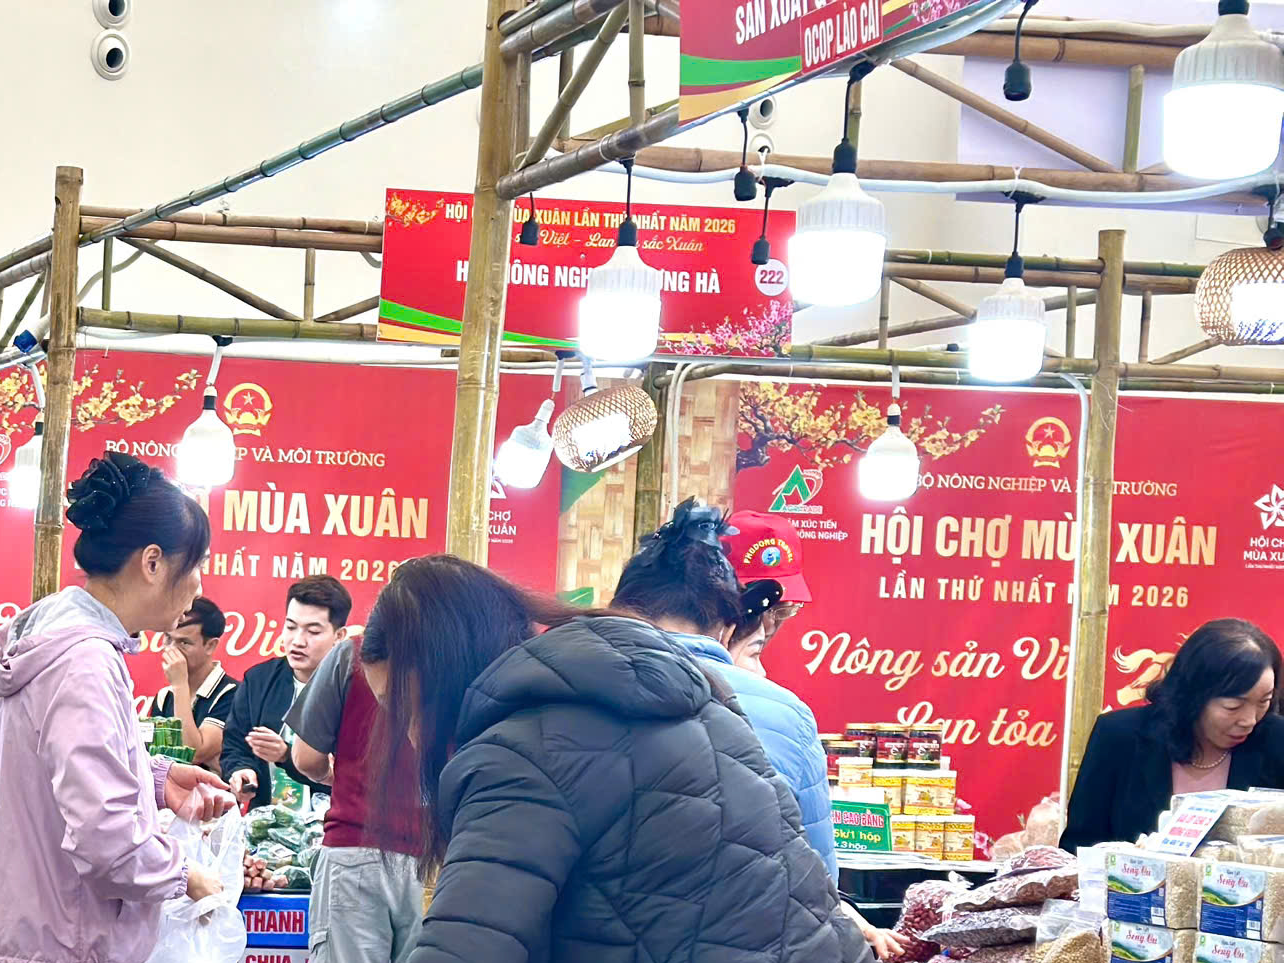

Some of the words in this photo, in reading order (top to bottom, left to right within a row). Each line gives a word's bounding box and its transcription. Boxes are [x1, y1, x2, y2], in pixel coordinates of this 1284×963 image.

[804, 18, 834, 68] OCOP
[445, 202, 468, 223] HỘI
[535, 208, 570, 226] XUÂN
[574, 207, 600, 228] LẦN
[632, 209, 667, 231] NHẤT
[669, 213, 701, 232] NĂM
[704, 218, 736, 234] 2026
[539, 230, 570, 248] Việt
[585, 232, 615, 248] Lan
[666, 236, 704, 252] Xuân
[695, 268, 720, 293] HÀ
[759, 269, 785, 285] 222
[251, 447, 274, 462] VÀ
[278, 448, 311, 464] MÔI
[316, 449, 386, 467] TRƯỜNG
[937, 474, 985, 490] NÔNG
[988, 476, 1047, 493] NGHIỆP
[1050, 478, 1072, 492] VÀ
[224, 482, 311, 534] MÙA
[322, 487, 429, 539] XUÂN
[860, 506, 924, 565] HỘI
[935, 514, 1012, 567] CHỢ
[1021, 512, 1077, 561] MÙ
[1116, 516, 1218, 566] XUÂN
[272, 552, 328, 579] NĂM
[1270, 551, 1284, 562] XU
[879, 570, 925, 600] LẦN
[938, 575, 984, 602] THỨ
[993, 574, 1056, 604] NHẤT
[1132, 586, 1189, 608] 2026
[801, 630, 924, 691] Nông
[931, 640, 1004, 678] sản
[1013, 636, 1069, 680] Vi
[987, 708, 1056, 746] tỏa
[244, 910, 305, 933] THANH
